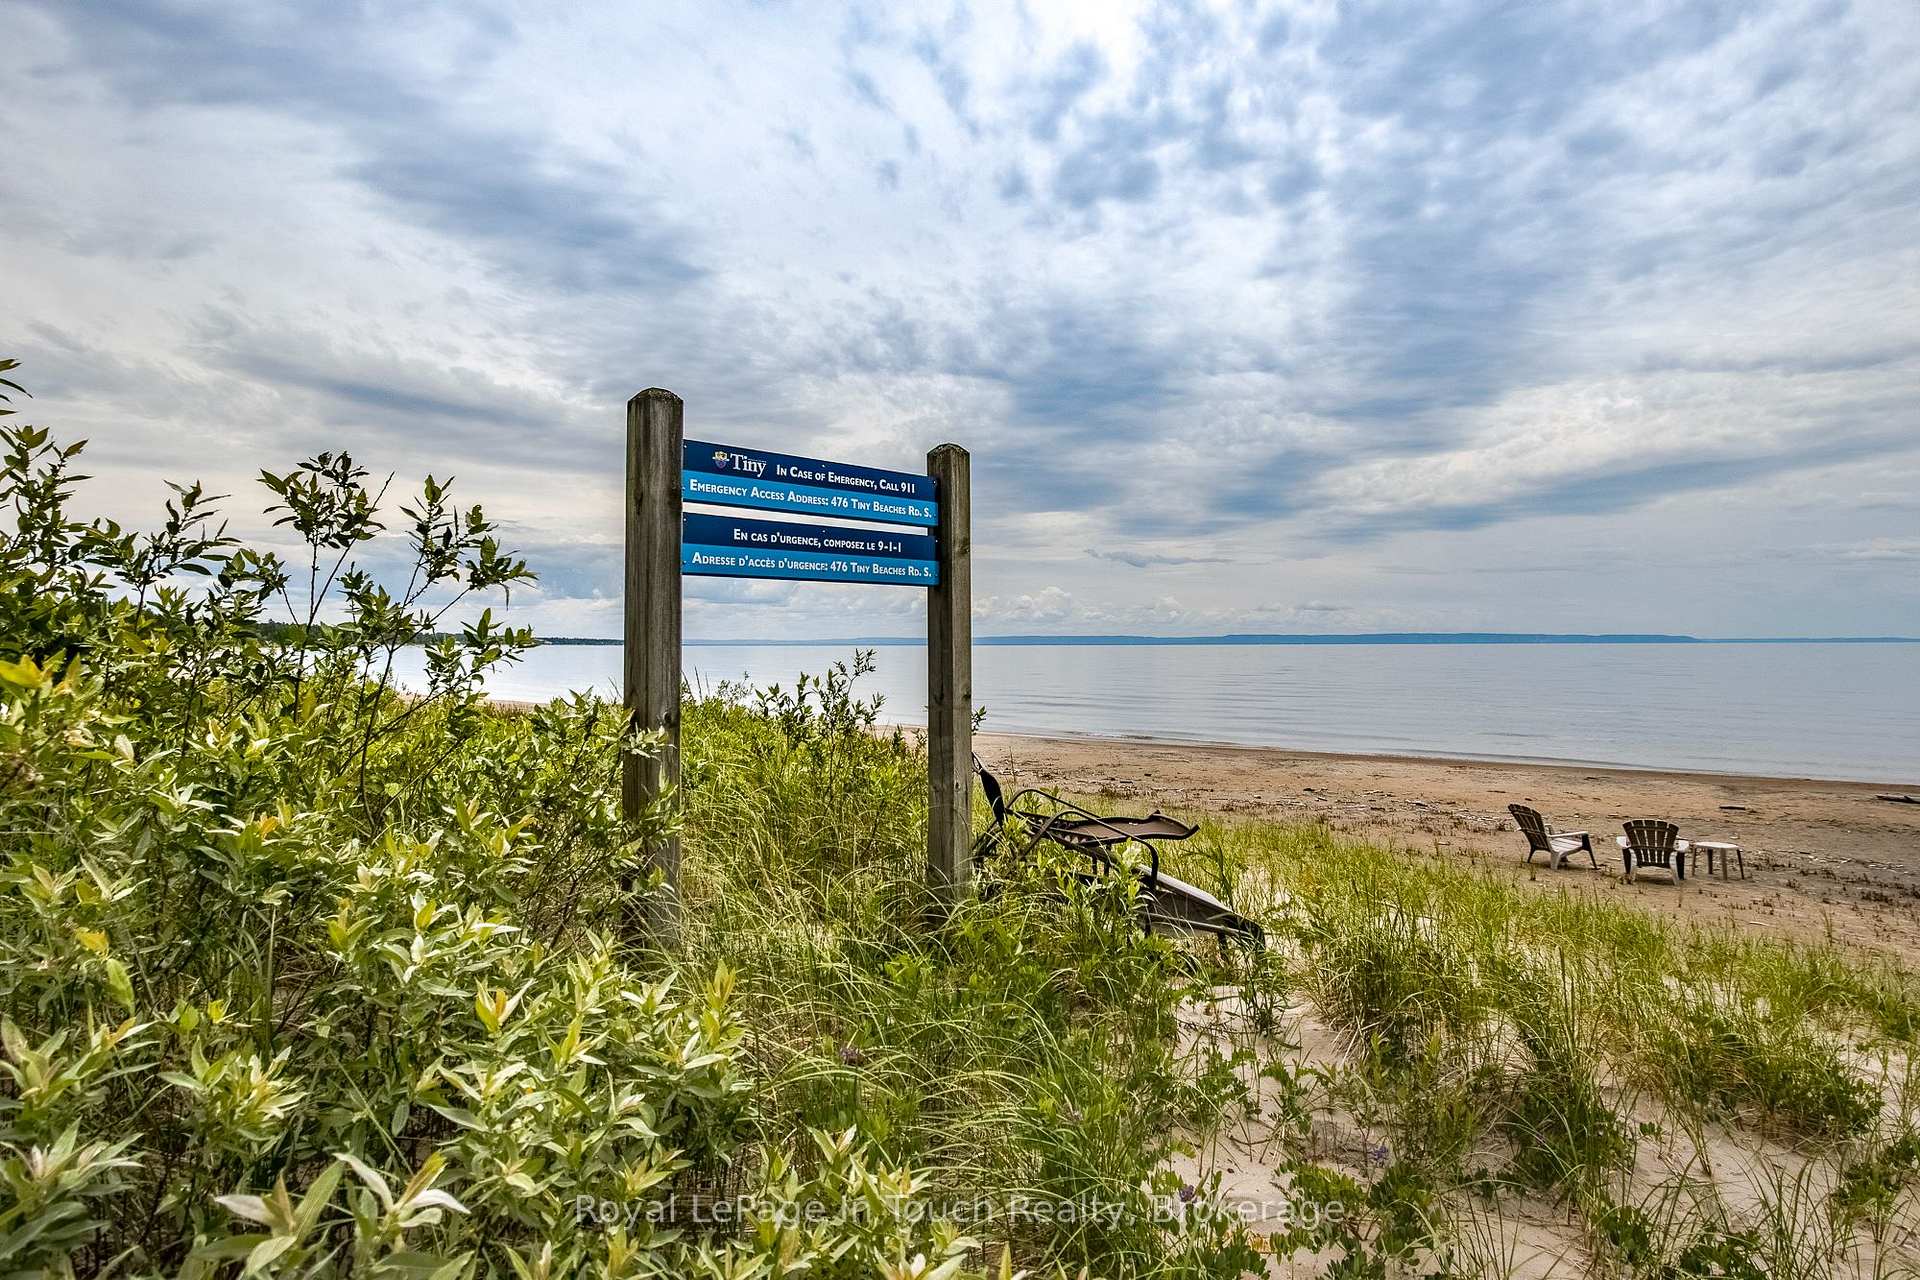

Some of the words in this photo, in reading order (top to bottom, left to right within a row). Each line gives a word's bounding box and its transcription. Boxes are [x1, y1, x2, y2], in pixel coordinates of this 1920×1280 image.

[730, 453, 767, 477] Tiny
[776, 464, 787, 476] IN
[790, 467, 813, 480] CASE
[815, 472, 826, 481] OF
[828, 472, 877, 490] EMERGENCY,
[879, 479, 899, 492] CALL
[901, 482, 915, 493] 911
[690, 479, 747, 497] EMERGENCY
[751, 487, 784, 501] ACCESS
[788, 491, 828, 506] ADDRESS:
[831, 497, 848, 508] 476
[851, 499, 870, 511] TINY
[873, 501, 906, 515] BEACHES
[908, 506, 922, 517] RD.
[924, 508, 932, 518] S.
[733, 528, 748, 541] EN
[751, 534, 768, 543] CAS
[771, 532, 821, 548] D'URGENCE,
[824, 539, 864, 550] COMPOSEZ
[867, 543, 876, 551] LE
[878, 541, 901, 553] 9-1-1
[692, 552, 736, 566] ADRESSE
[779, 557, 828, 571] D'URGENCE:
[830, 561, 848, 572] 476
[850, 562, 870, 574] TINY
[872, 564, 906, 576] BEACHES
[908, 566, 922, 577] RD.
[923, 567, 932, 577] S.
